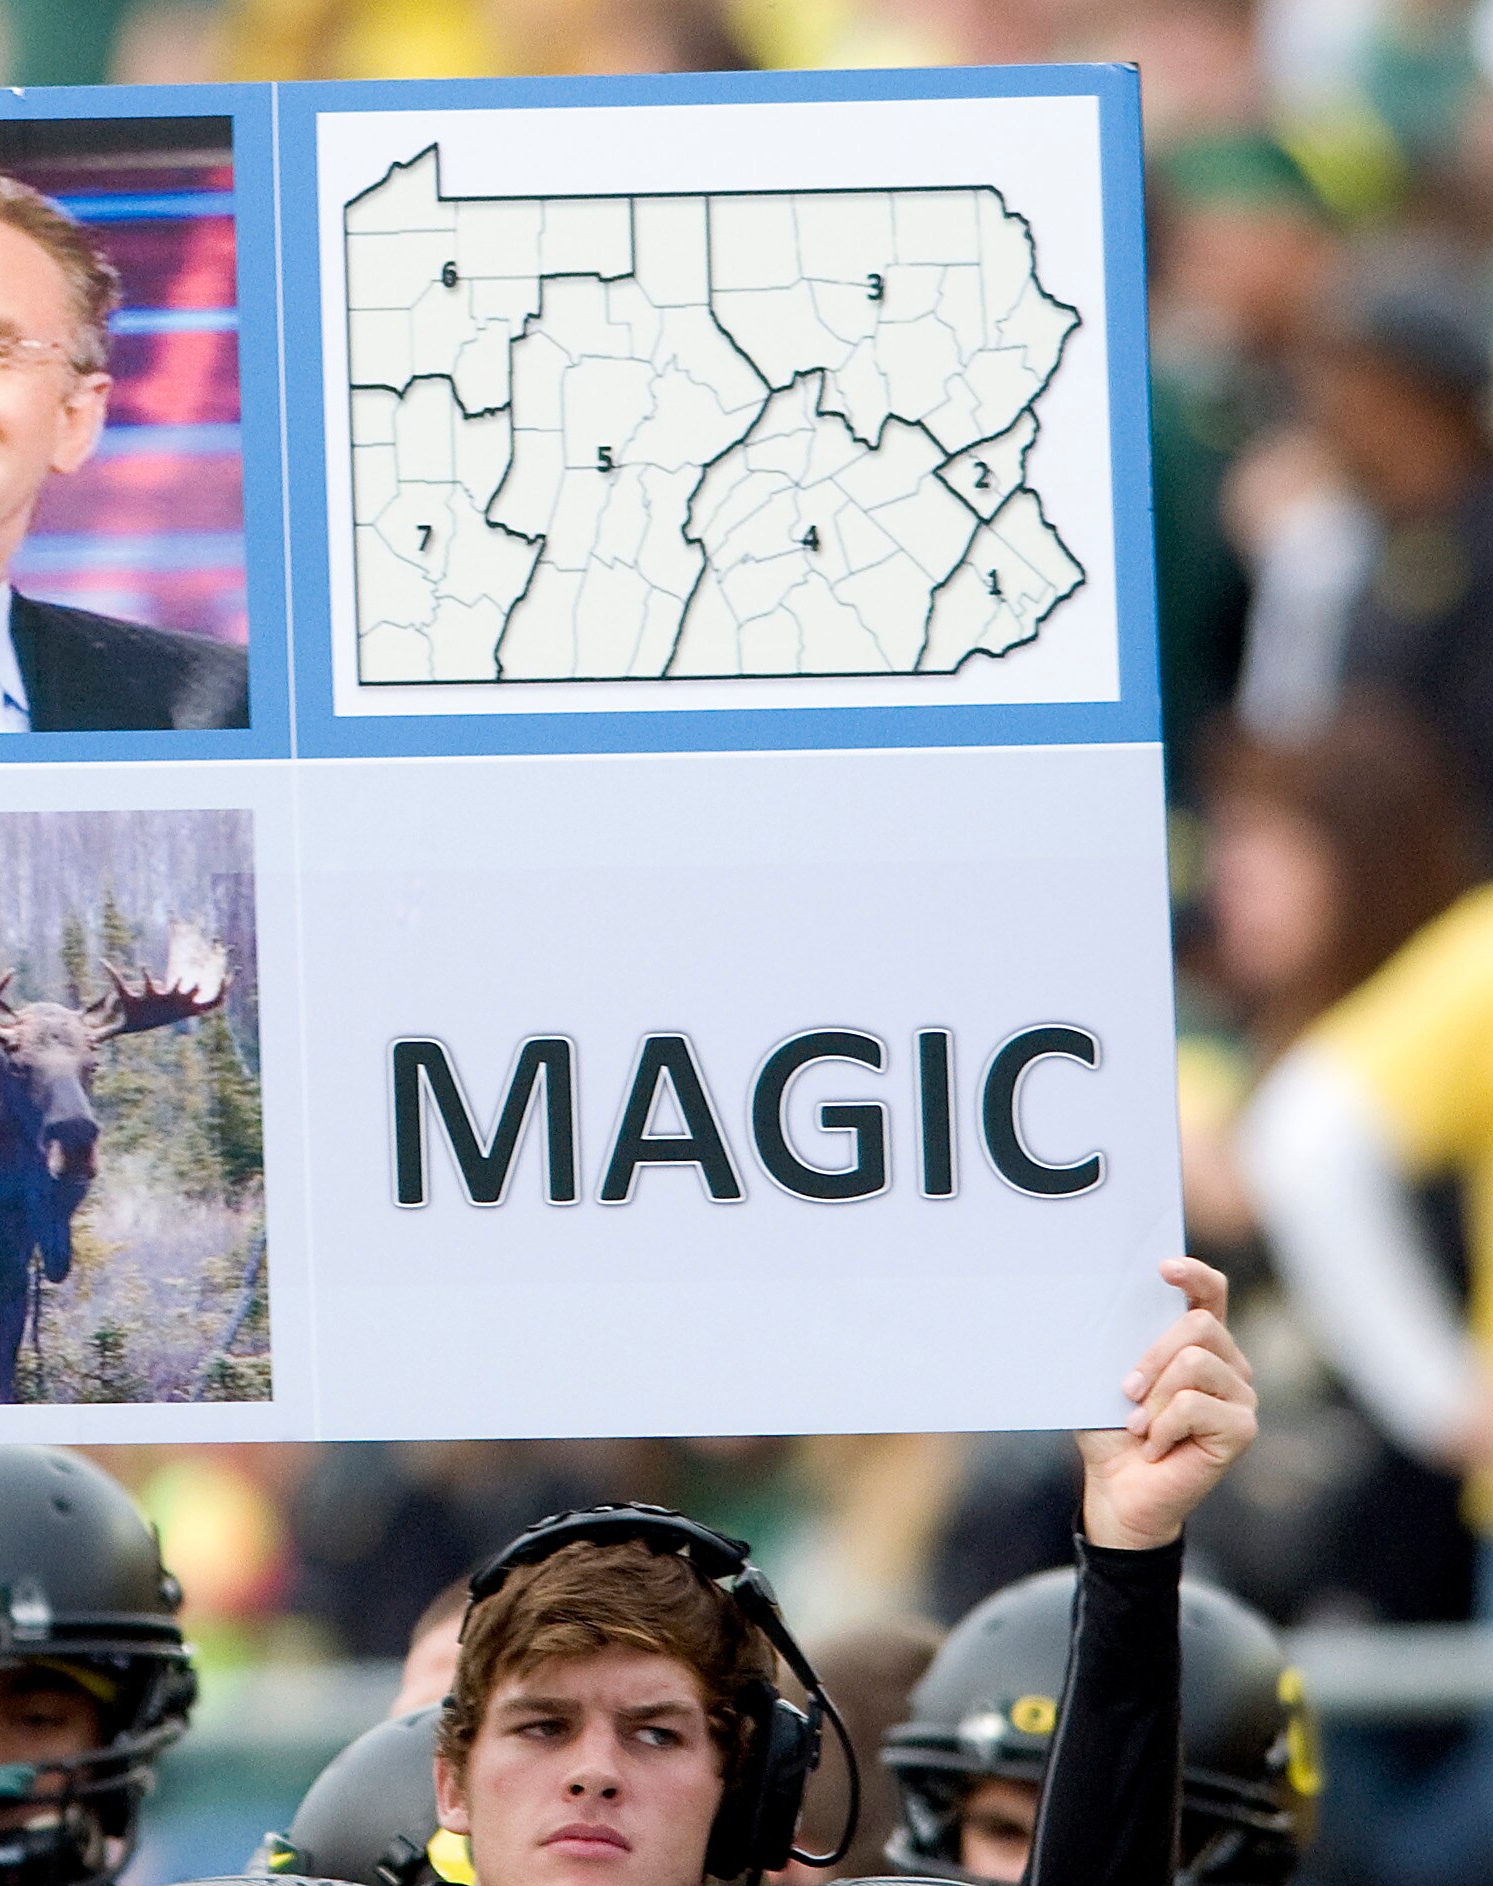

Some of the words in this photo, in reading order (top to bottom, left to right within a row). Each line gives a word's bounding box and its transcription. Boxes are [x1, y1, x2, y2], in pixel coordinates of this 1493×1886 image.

[441, 261, 459, 288] 6
[867, 273, 884, 300] 3
[597, 446, 615, 472] 5
[974, 461, 991, 488] 2
[417, 525, 433, 551] 7
[800, 525, 819, 551] 4
[988, 569, 1002, 596] 1
[390, 1023, 1104, 1207] MAGIC
